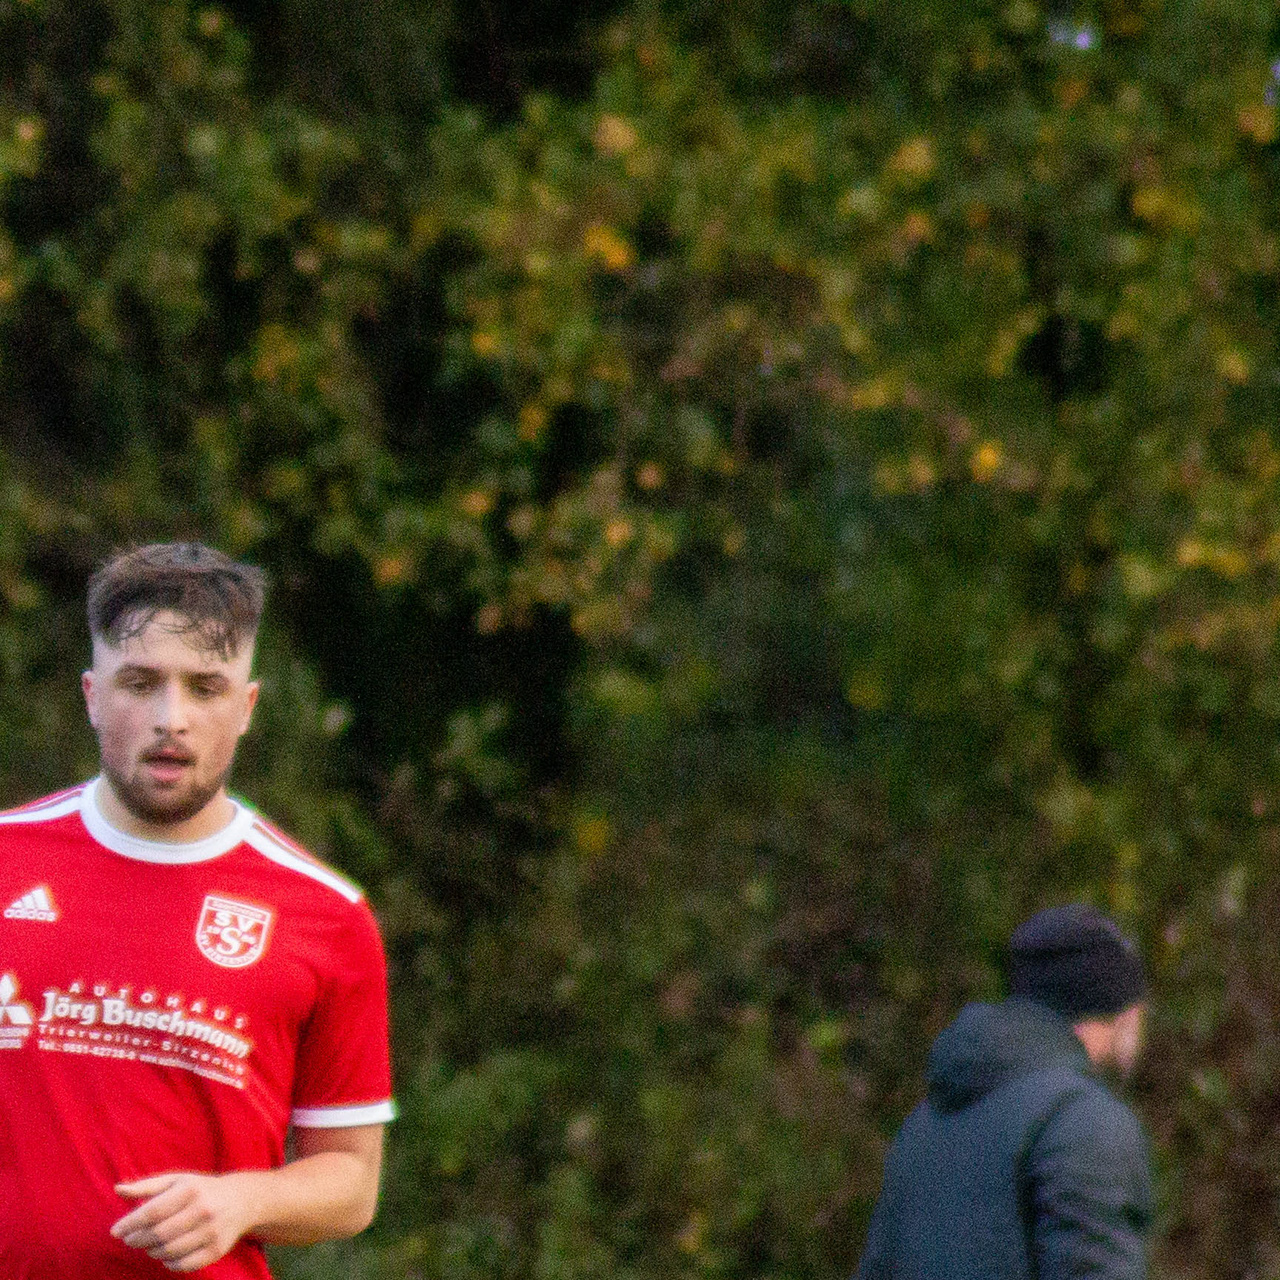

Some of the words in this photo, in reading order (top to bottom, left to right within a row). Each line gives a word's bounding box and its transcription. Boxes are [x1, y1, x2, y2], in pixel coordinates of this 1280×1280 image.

[3, 908, 56, 922] adidas
[39, 991, 97, 1025] Jörg
[102, 998, 251, 1059] Buschmann
[69, 983, 244, 1029] AUTOHAUS
